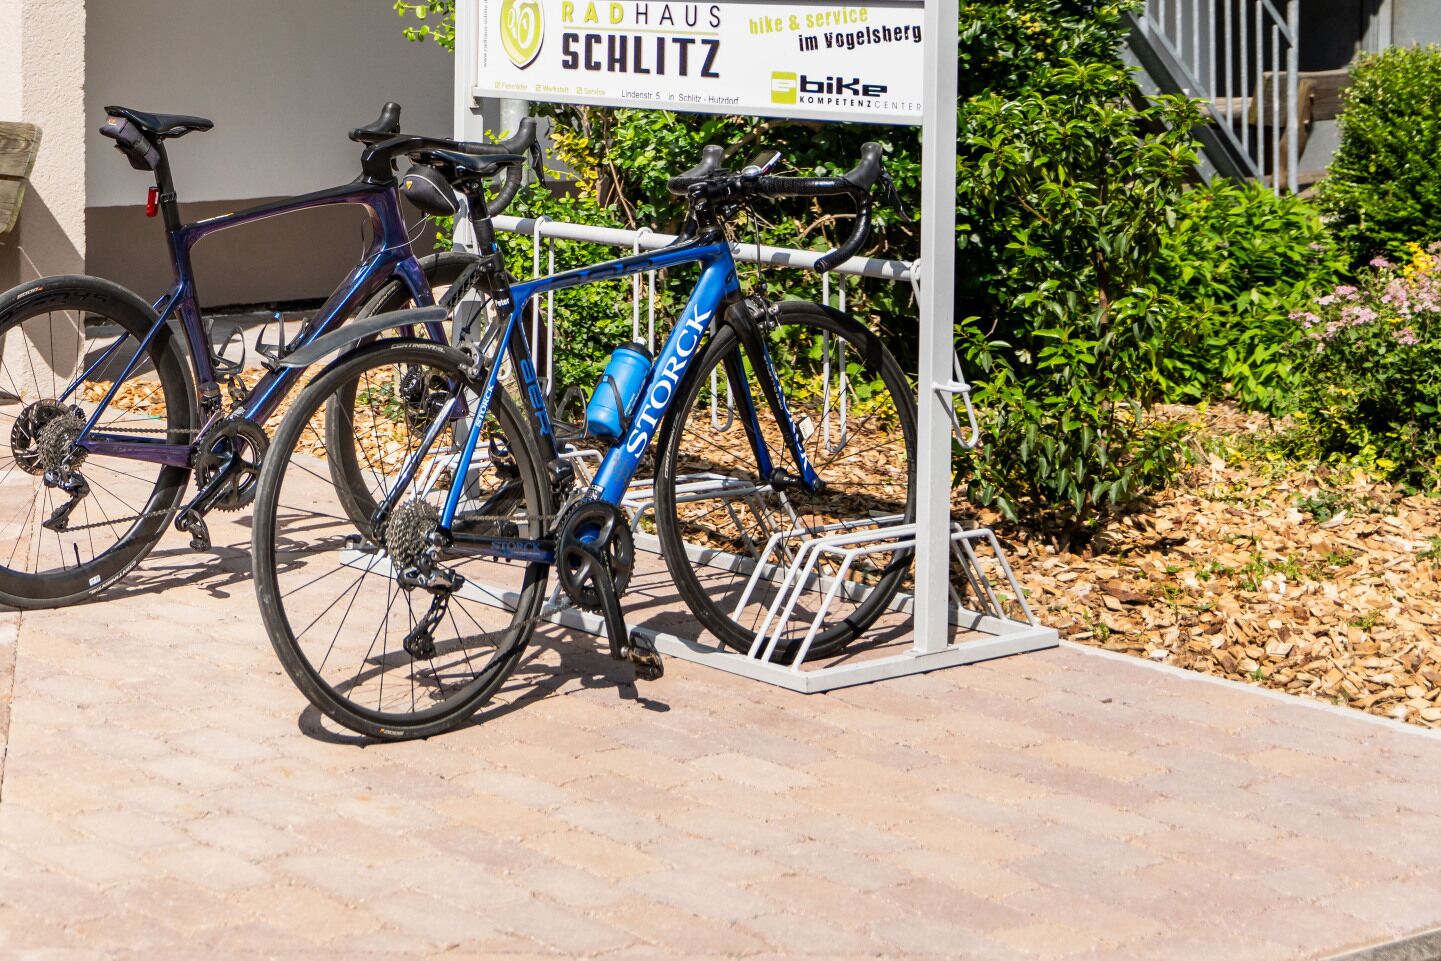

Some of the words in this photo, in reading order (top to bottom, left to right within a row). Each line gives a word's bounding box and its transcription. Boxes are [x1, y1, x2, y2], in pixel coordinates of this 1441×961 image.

[562, 1, 720, 27] RADHAUS
[749, 16, 782, 35] bike
[789, 15, 800, 30] &
[806, 7, 868, 28] service
[799, 35, 818, 51] im
[824, 25, 922, 50] Vogelsberg
[562, 32, 720, 78] SCHLITZ
[678, 93, 702, 103] Schlitz
[626, 304, 712, 458] STORCK
[474, 385, 494, 428] STORCK
[492, 541, 541, 553] STORCK
